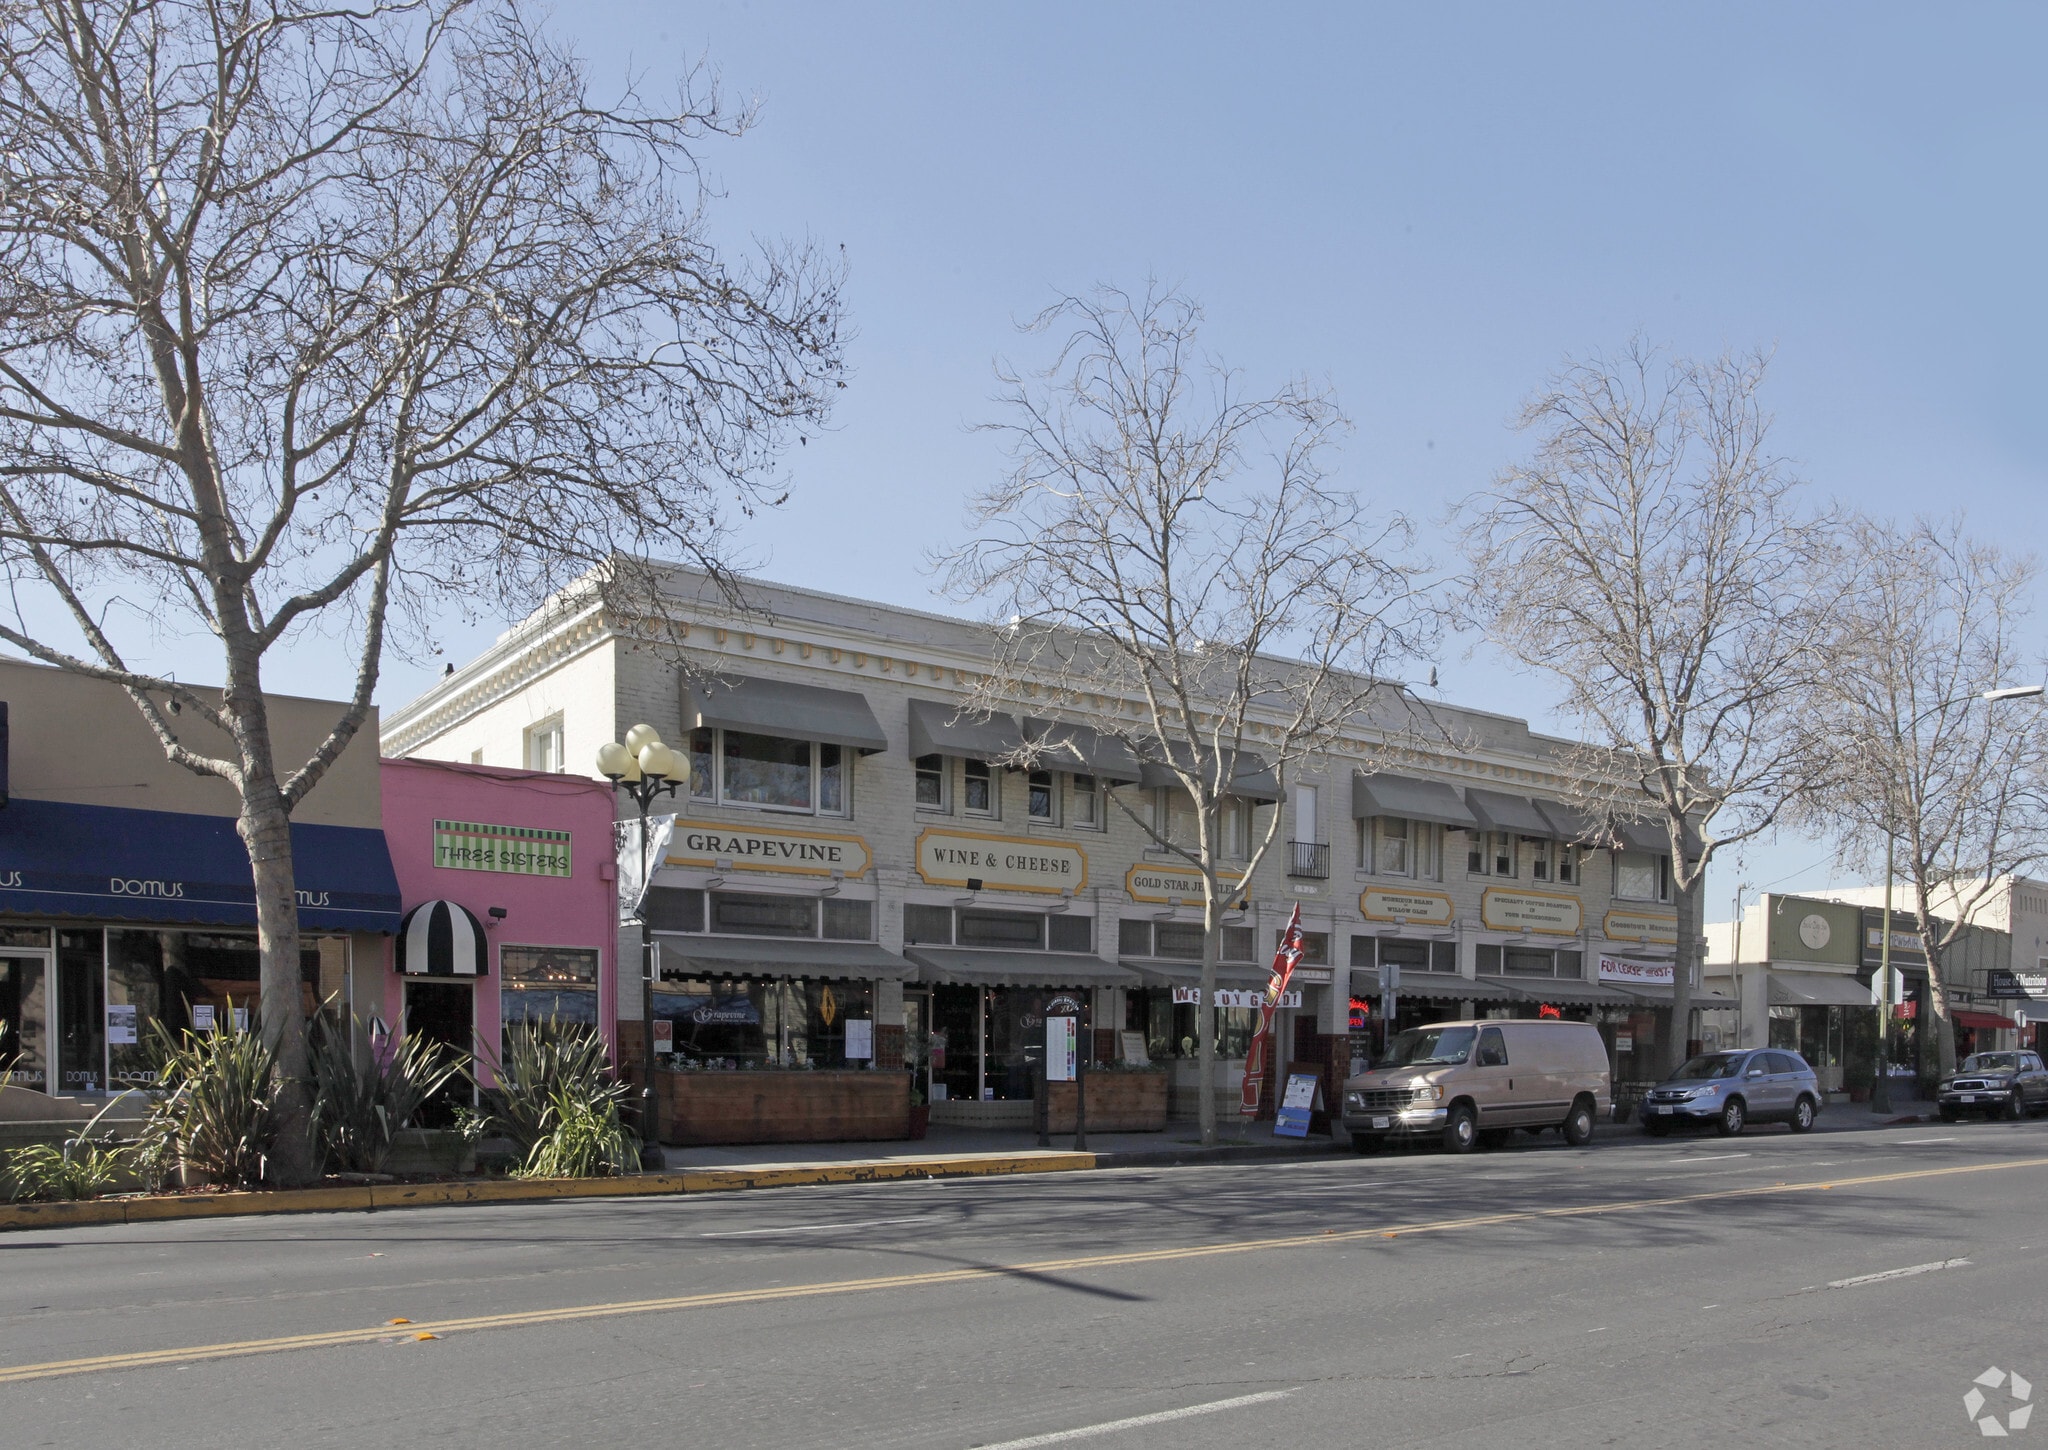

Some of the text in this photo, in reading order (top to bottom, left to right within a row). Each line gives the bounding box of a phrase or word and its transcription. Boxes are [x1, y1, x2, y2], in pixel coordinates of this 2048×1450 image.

[438, 846, 568, 869] THREE SISTERS
[686, 834, 842, 862] GRAPEVINE
[934, 847, 1071, 874] WINE & CHEESE
[1134, 876, 1161, 888] GOLD
[1163, 879, 1190, 891] STAR
[1993, 974, 2011, 986] House
[2020, 973, 2047, 986] Nutrition
[1214, 993, 1241, 1005] UY
